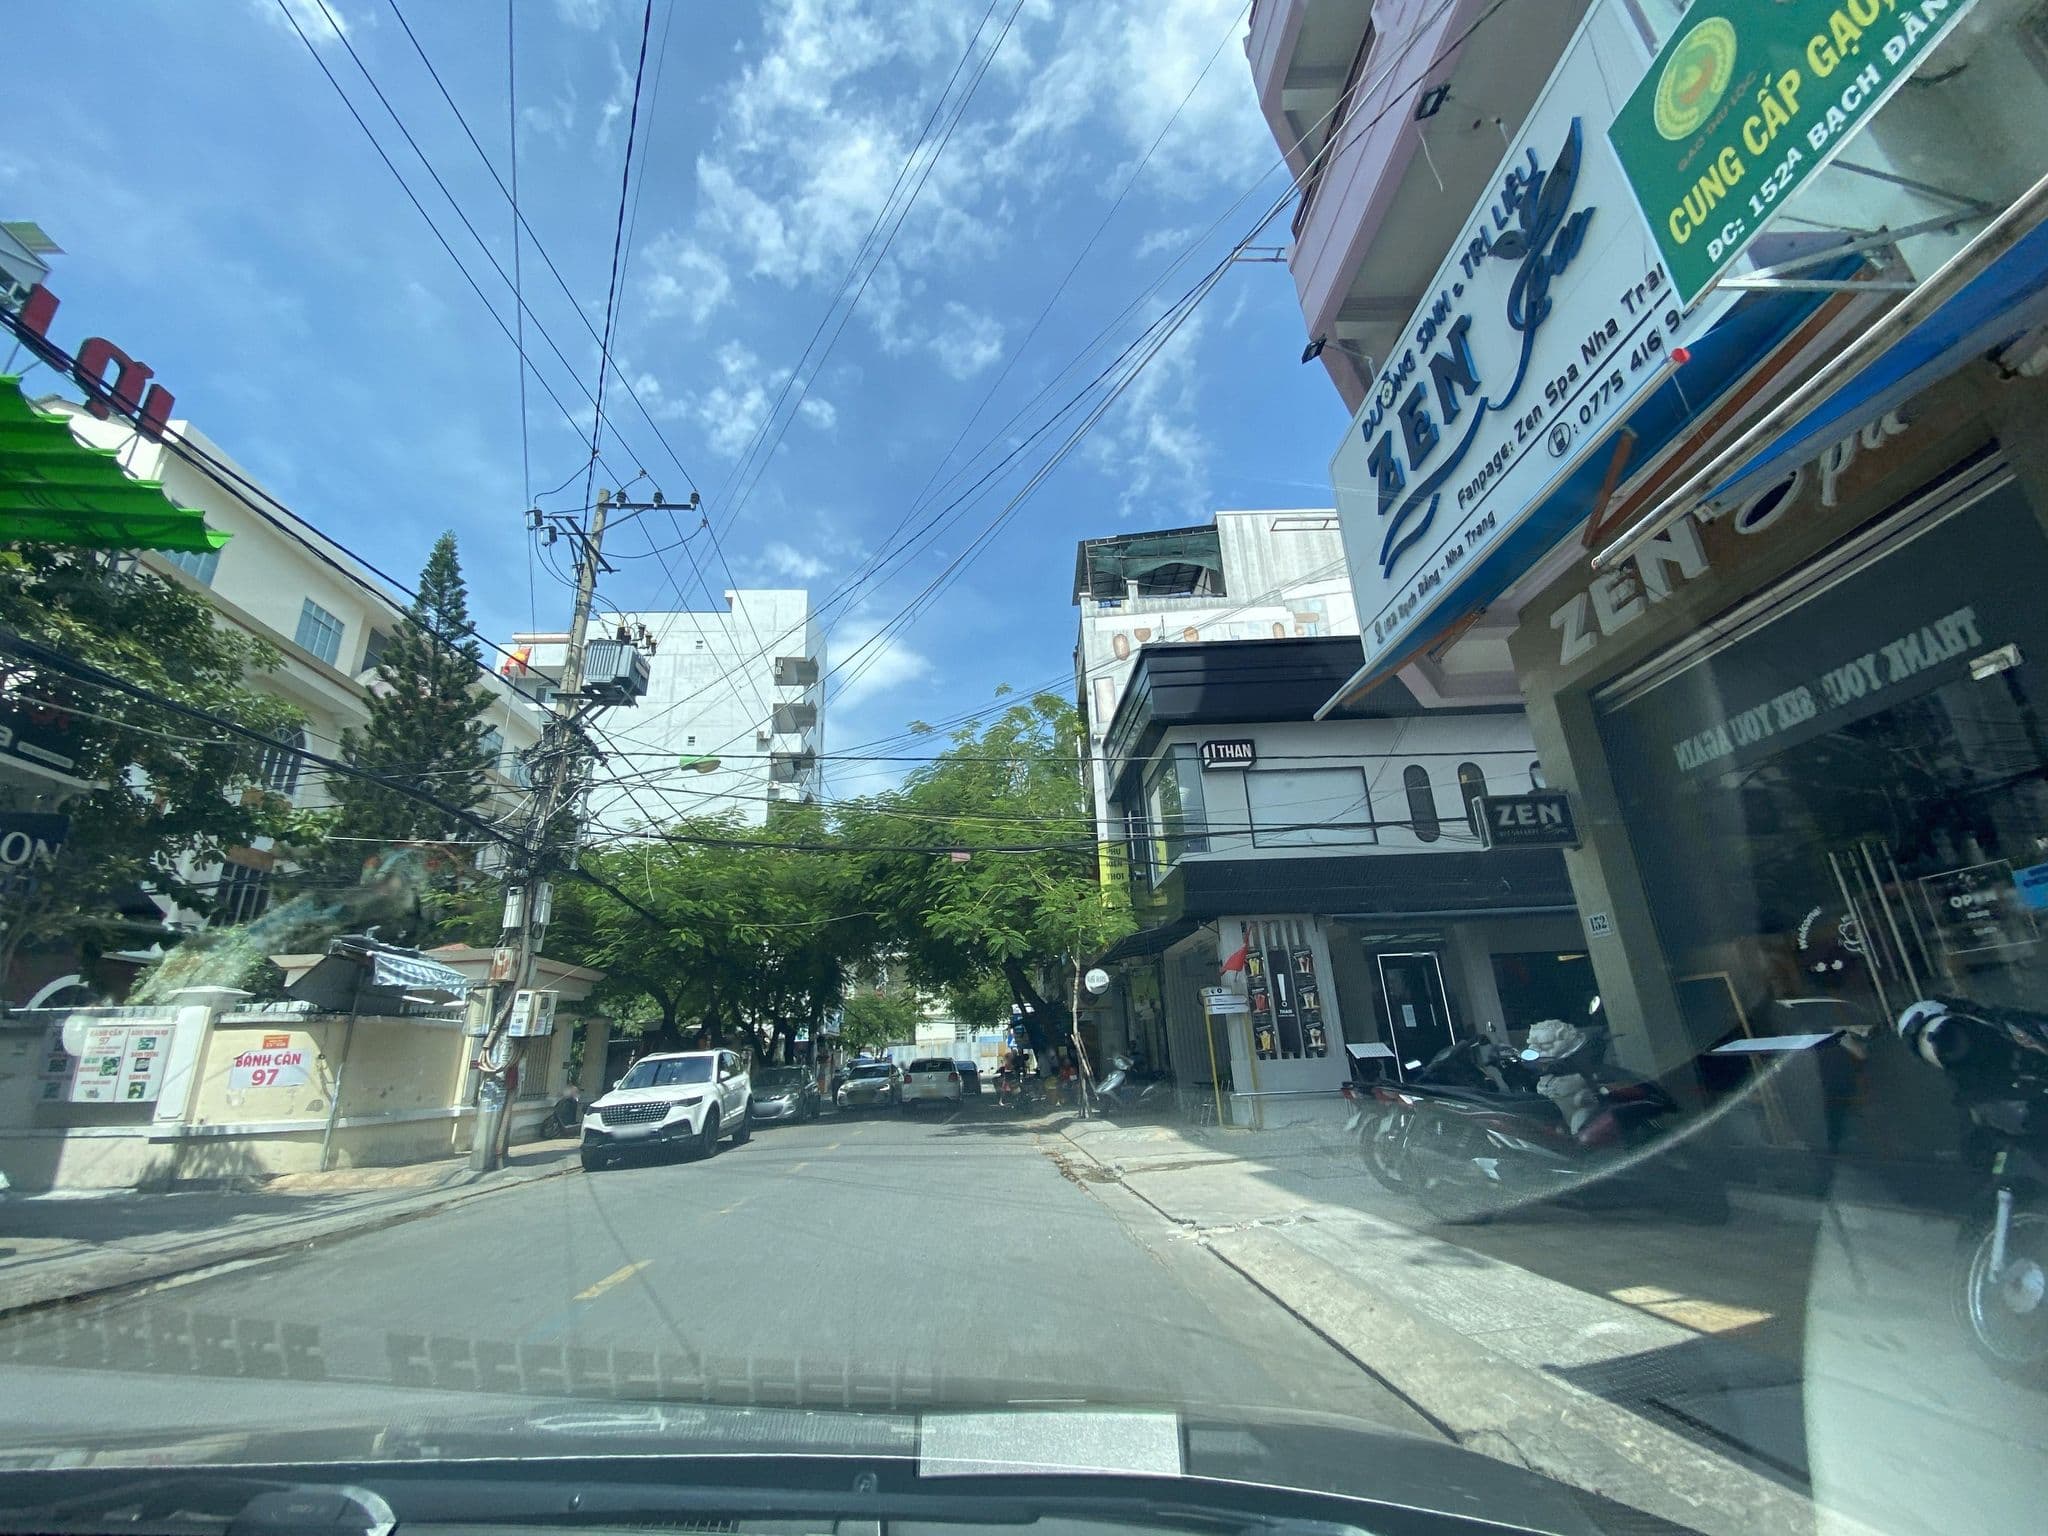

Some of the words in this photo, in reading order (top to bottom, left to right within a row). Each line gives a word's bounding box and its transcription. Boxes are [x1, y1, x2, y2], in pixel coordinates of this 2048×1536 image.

[1668, 146, 1746, 245] CUNG
[1742, 69, 1801, 156] CẤP
[1706, 218, 1746, 263] ĐC:
[1749, 147, 1803, 218] 152A
[1806, 63, 1881, 151] BẠCH
[1367, 314, 1482, 516] ZEN
[1457, 440, 1516, 510] Fanpage:
[1513, 404, 1545, 445] Zen
[1544, 361, 1579, 408] Spa
[1580, 317, 1620, 366] Nha
[1579, 368, 1625, 426] 0775
[1630, 329, 1664, 373] 416
[1444, 543, 1464, 568] Nha
[1464, 510, 1497, 547] Trang
[1550, 512, 1711, 666] ZEN
[1497, 803, 1562, 825] ZEN
[1590, 915, 1608, 931] 152
[251, 1068, 279, 1086] 97
